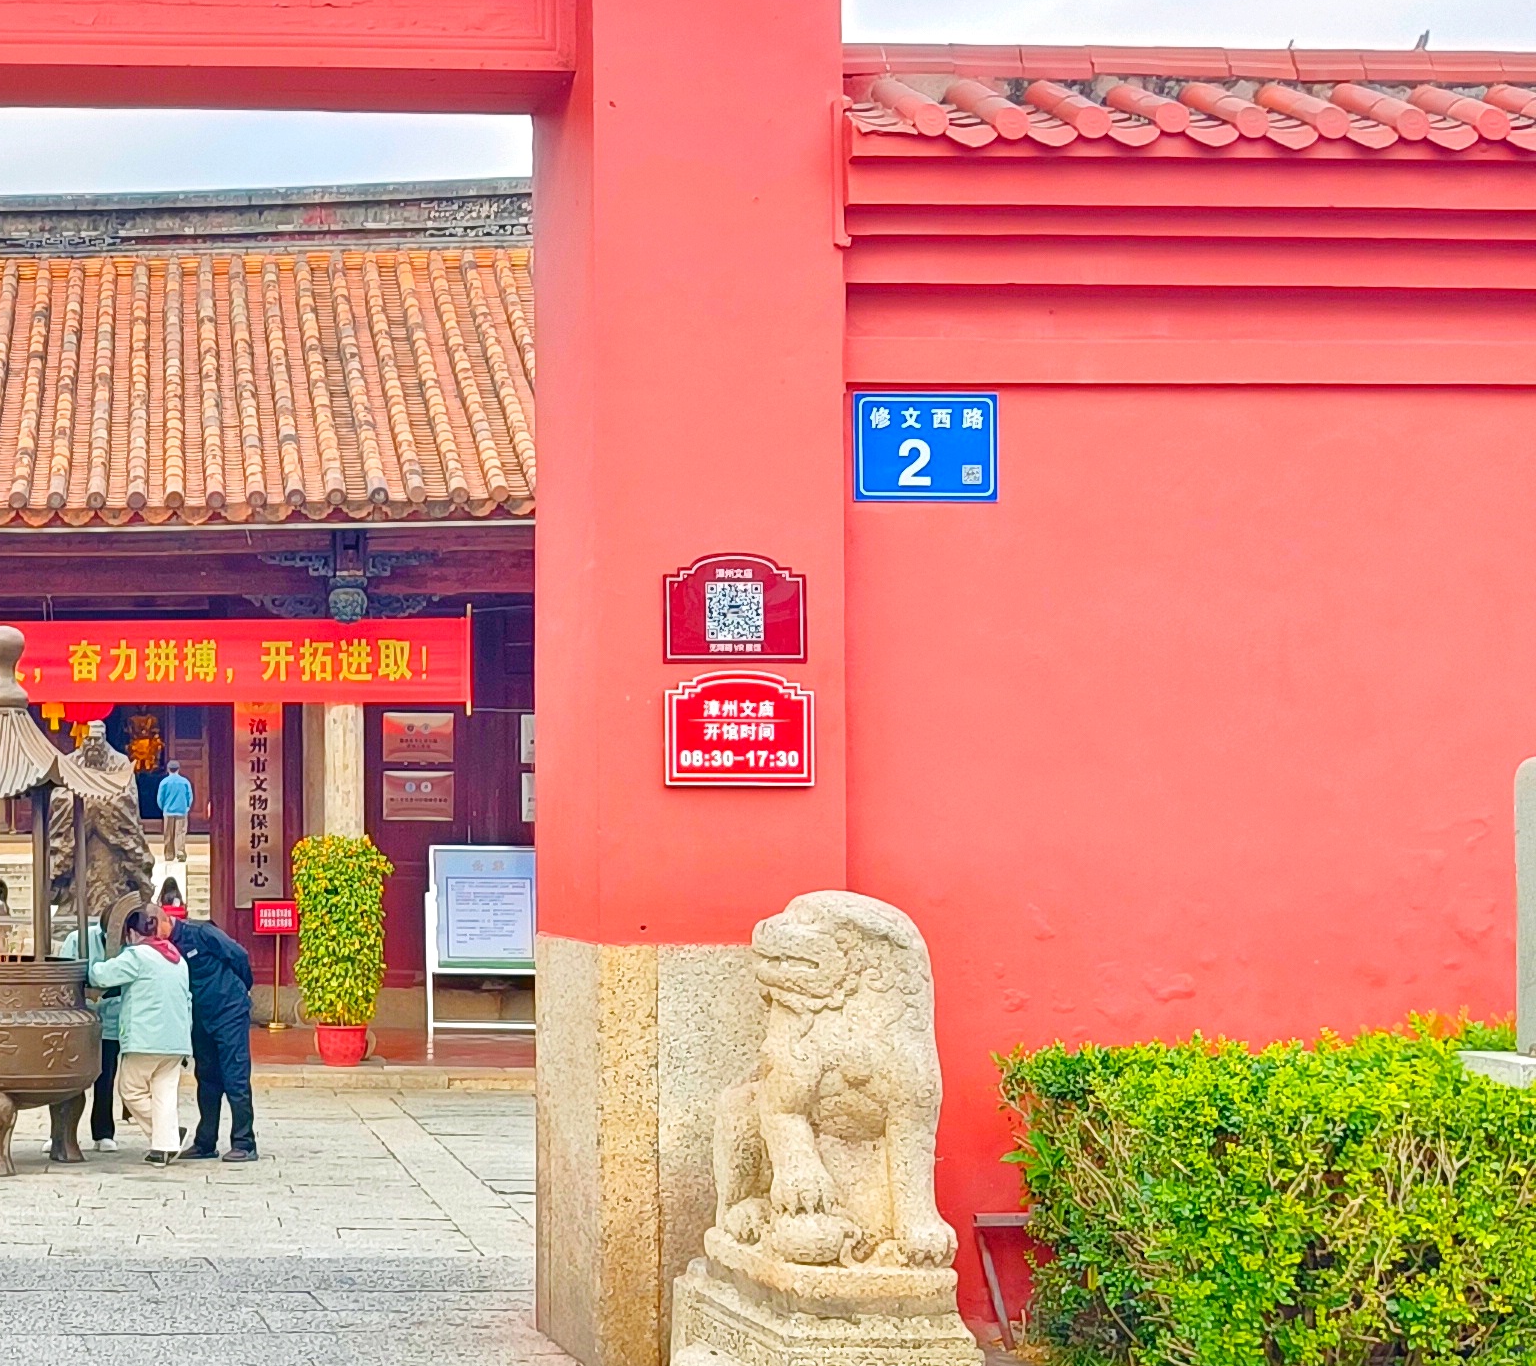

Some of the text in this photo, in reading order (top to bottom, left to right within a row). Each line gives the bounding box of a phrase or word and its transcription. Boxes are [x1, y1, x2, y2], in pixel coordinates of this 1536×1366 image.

[869, 406, 984, 431] 修文西路
[897, 438, 932, 487] 2
[703, 700, 775, 718] 漳州文庙
[703, 723, 775, 742] 开馆时间
[249, 718, 269, 888] 漳州市文物保护中心
